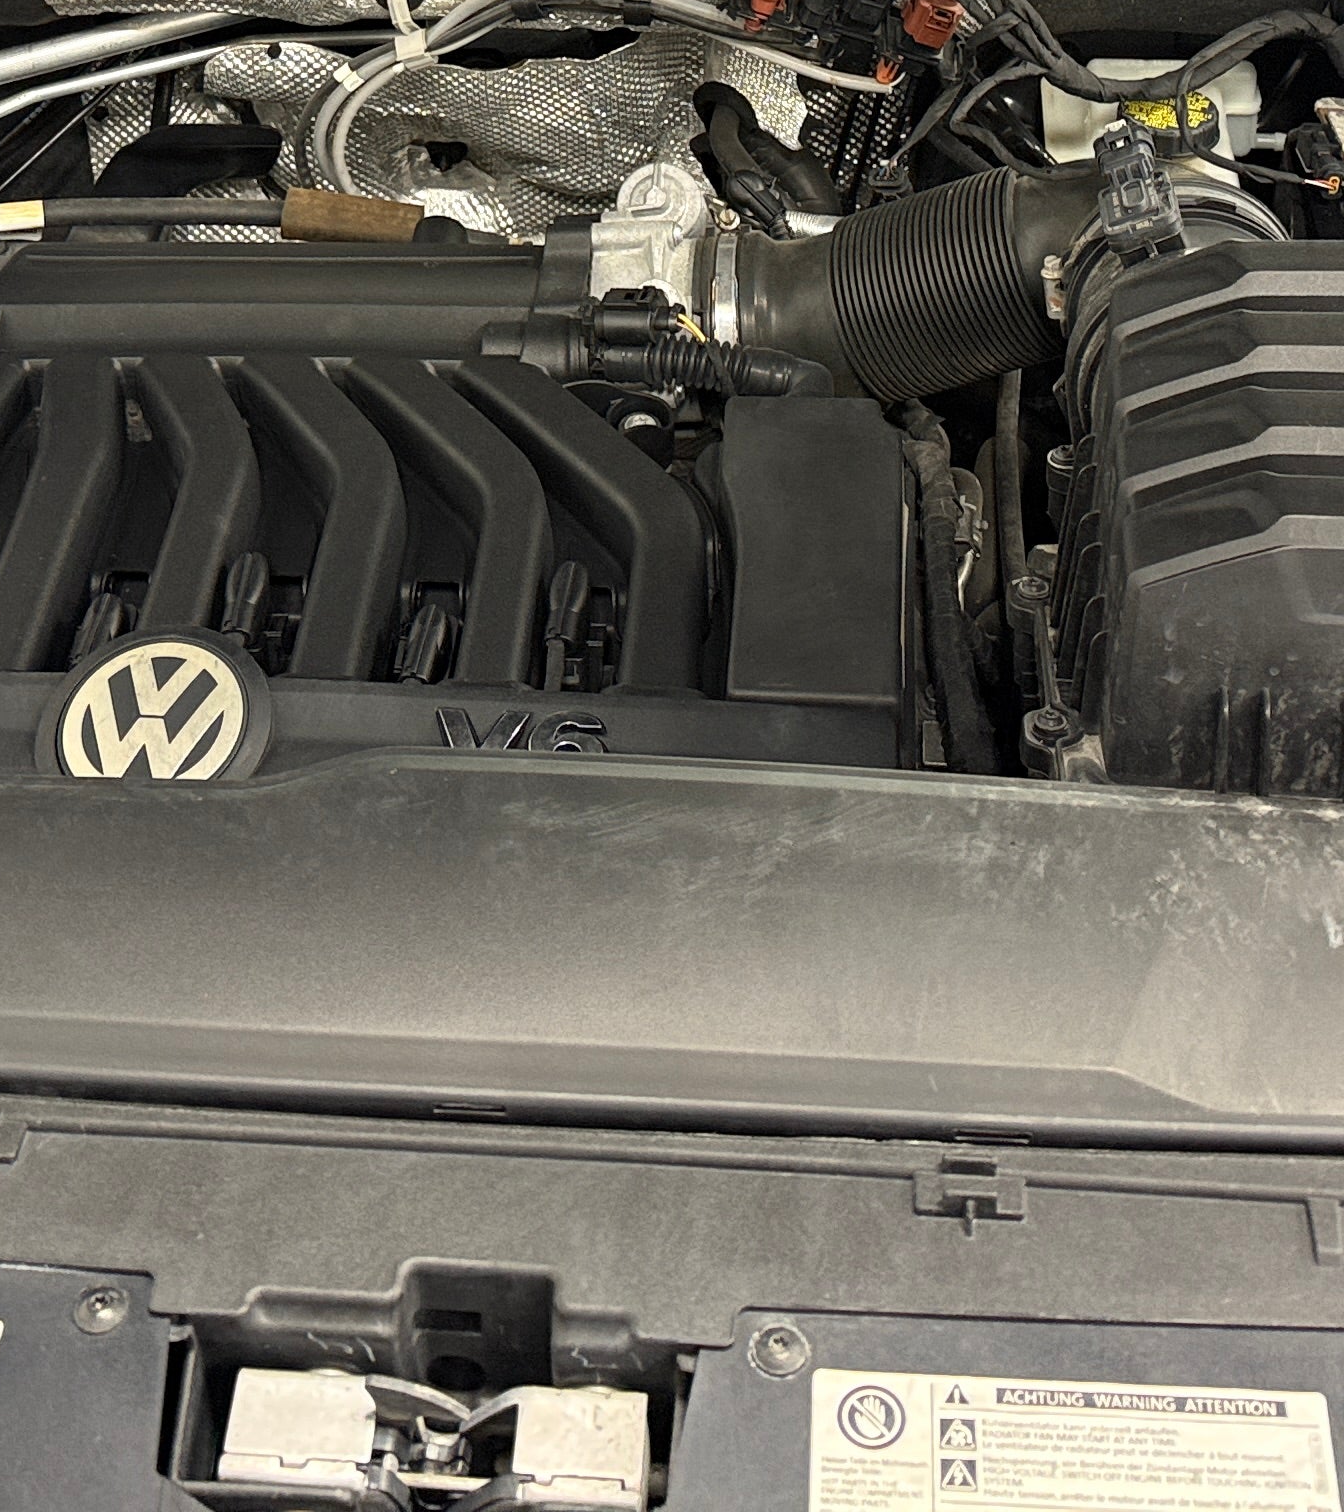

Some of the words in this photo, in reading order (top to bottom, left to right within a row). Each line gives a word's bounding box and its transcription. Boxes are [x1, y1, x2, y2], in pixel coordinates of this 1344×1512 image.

[435, 705, 610, 753] V6
[1002, 1389, 1085, 1408] ACHTUNG
[1092, 1392, 1177, 1412] WARNING
[1184, 1397, 1278, 1416] ATTENTION
